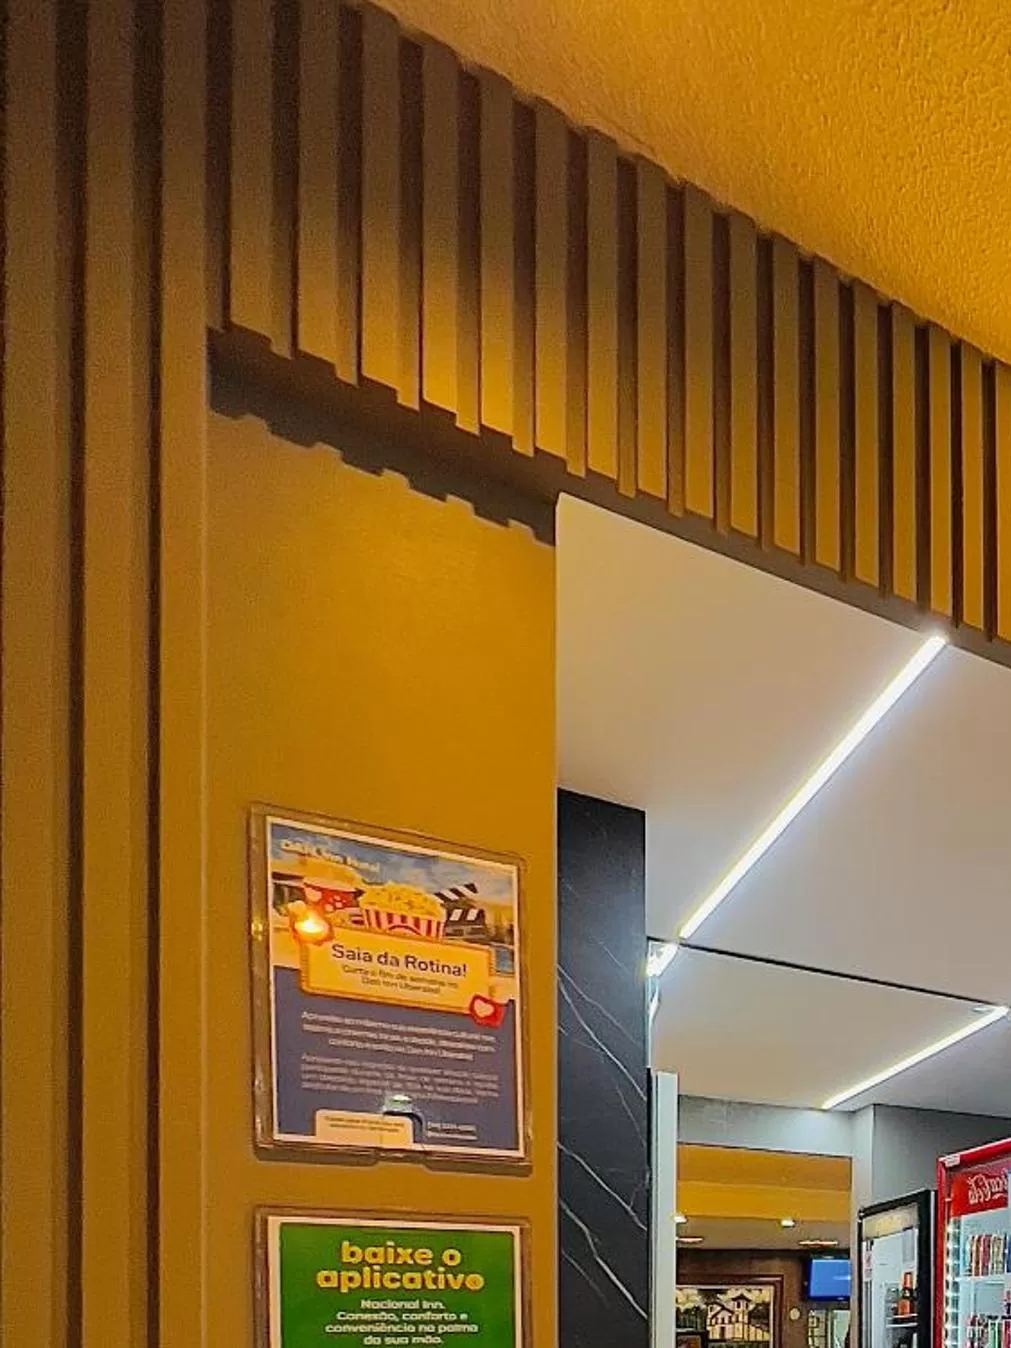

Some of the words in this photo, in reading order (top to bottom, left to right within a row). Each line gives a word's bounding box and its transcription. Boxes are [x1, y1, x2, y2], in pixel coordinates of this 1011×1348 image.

[332, 944, 372, 962] Saia
[377, 952, 400, 967] da
[404, 955, 467, 977] Rotina!
[340, 1241, 434, 1265] baixe
[442, 1248, 462, 1266] o
[316, 1265, 485, 1294] aplicativo
[360, 1300, 420, 1310] Nacional
[402, 1311, 457, 1321] conforto
[384, 1337, 409, 1345] sua
